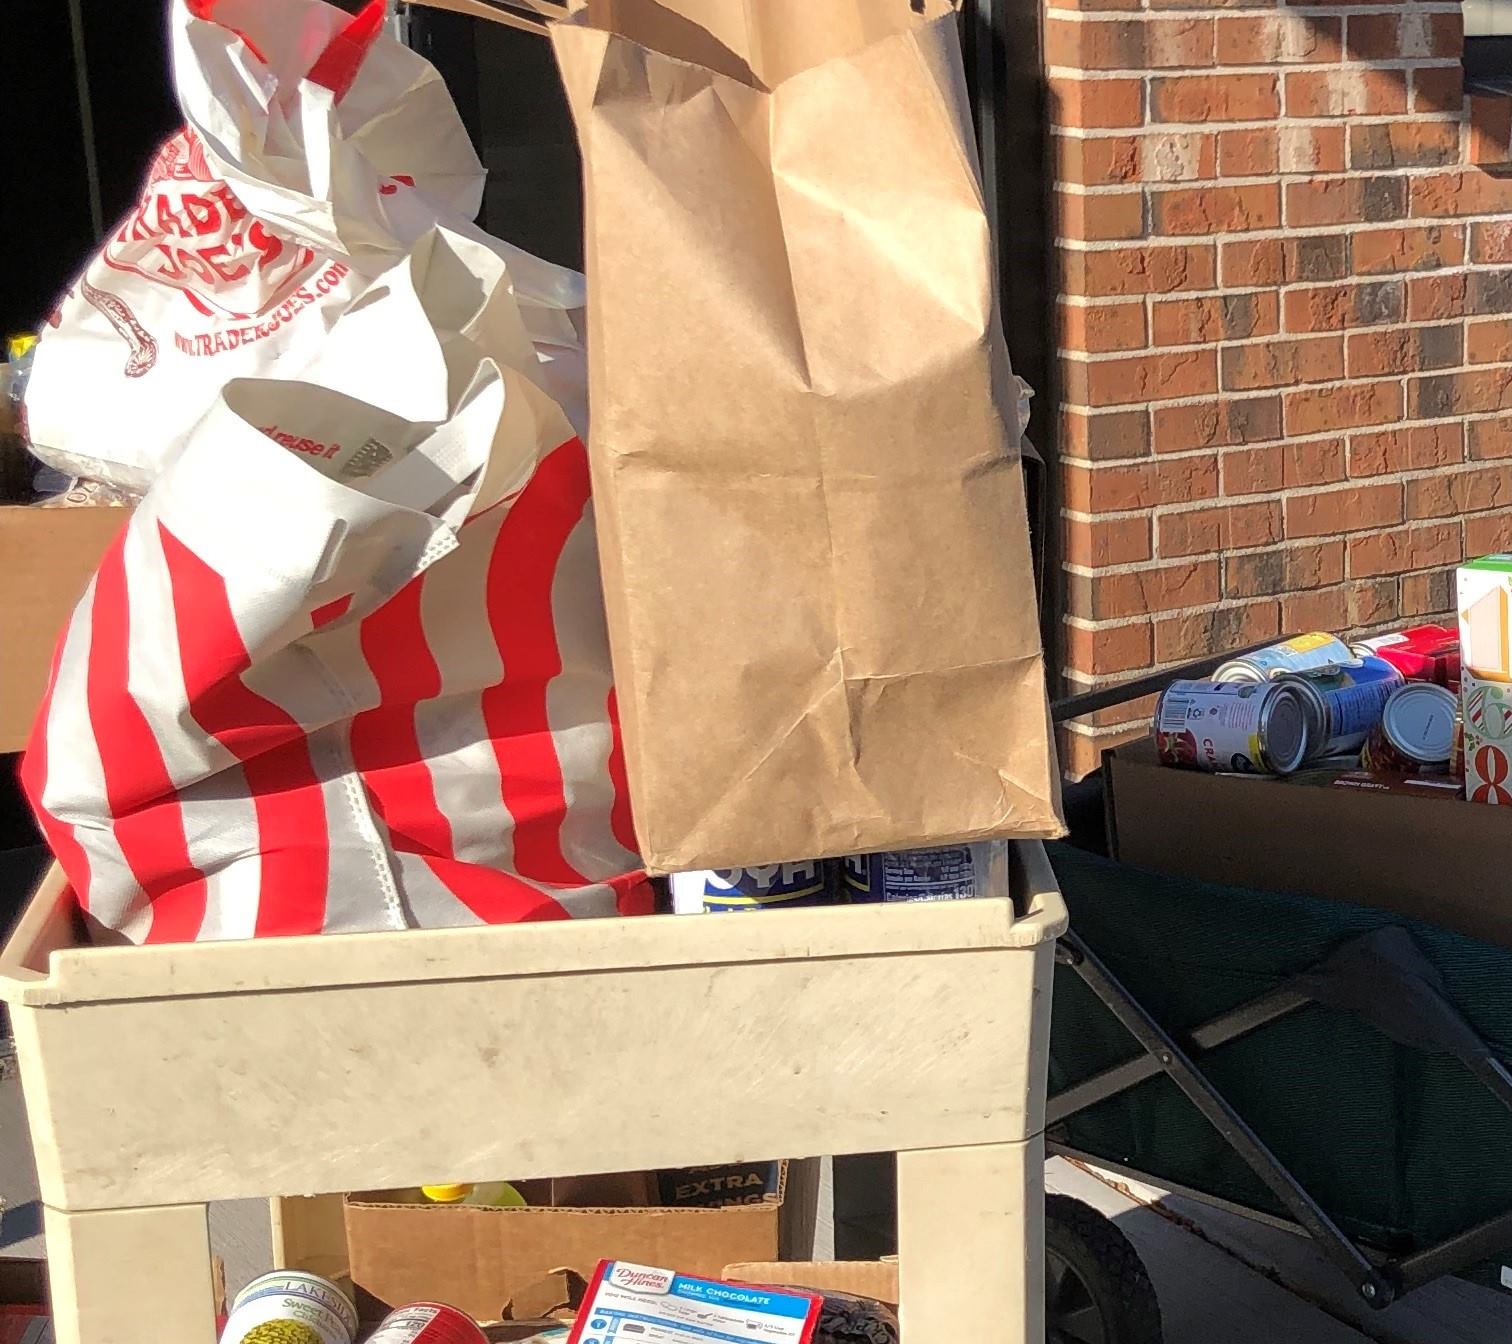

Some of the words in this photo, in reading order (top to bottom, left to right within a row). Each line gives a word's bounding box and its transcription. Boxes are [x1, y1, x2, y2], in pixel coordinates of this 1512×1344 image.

[323, 443, 341, 459] it
[954, 885, 973, 900] 130
[675, 1173, 764, 1200] EXTRA
[616, 1267, 668, 1284] Duncan
[678, 1282, 703, 1294] MILK
[706, 1287, 770, 1306] CHOCOLATE
